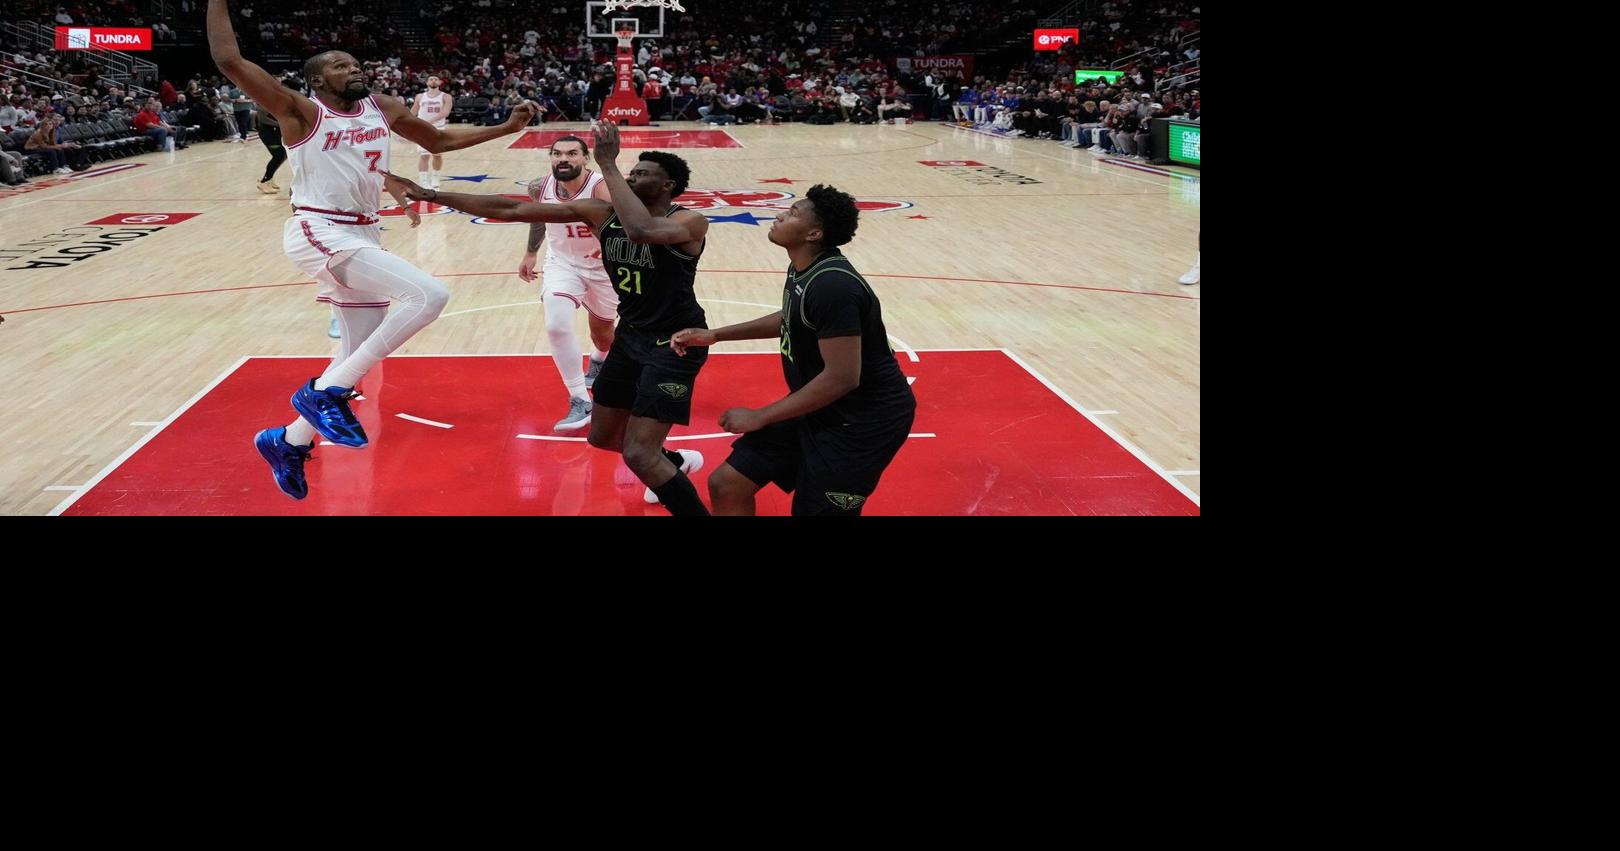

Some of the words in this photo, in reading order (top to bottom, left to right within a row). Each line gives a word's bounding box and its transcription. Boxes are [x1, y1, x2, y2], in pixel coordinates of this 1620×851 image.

[94, 34, 141, 44] TUNDRA
[913, 58, 965, 68] TUNDRA
[608, 107, 641, 116] xfinity
[322, 127, 387, 151] H-Town
[364, 151, 382, 173] 7
[565, 224, 592, 239] 12
[6, 226, 168, 271] TOYOTA
[605, 237, 655, 269] NOLA
[617, 266, 642, 295] 21
